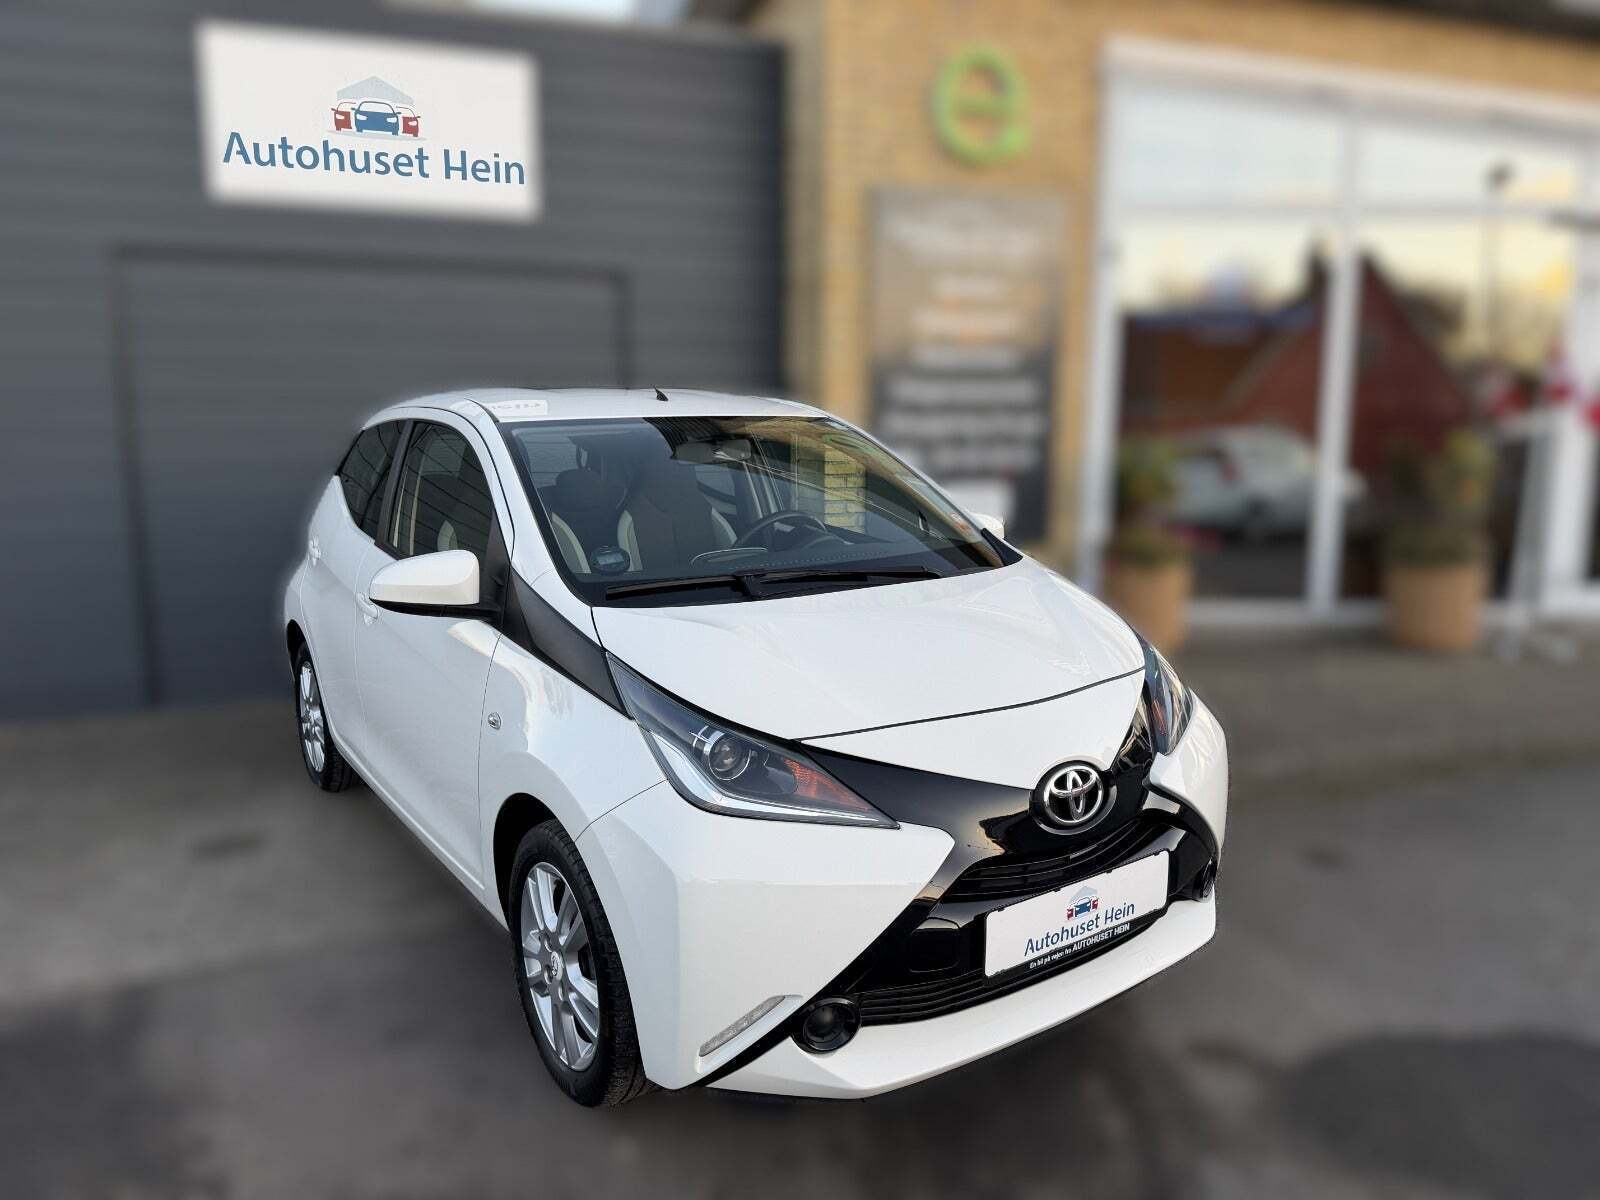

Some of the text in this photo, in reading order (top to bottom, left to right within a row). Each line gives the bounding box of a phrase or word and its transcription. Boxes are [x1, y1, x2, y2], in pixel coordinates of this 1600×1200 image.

[223, 132, 525, 184] Autohuset Hein
[1024, 902, 1135, 956] Autohuset Hein
[1072, 930, 1114, 952] AUTOHUSET
[1114, 923, 1130, 936] HEIN
